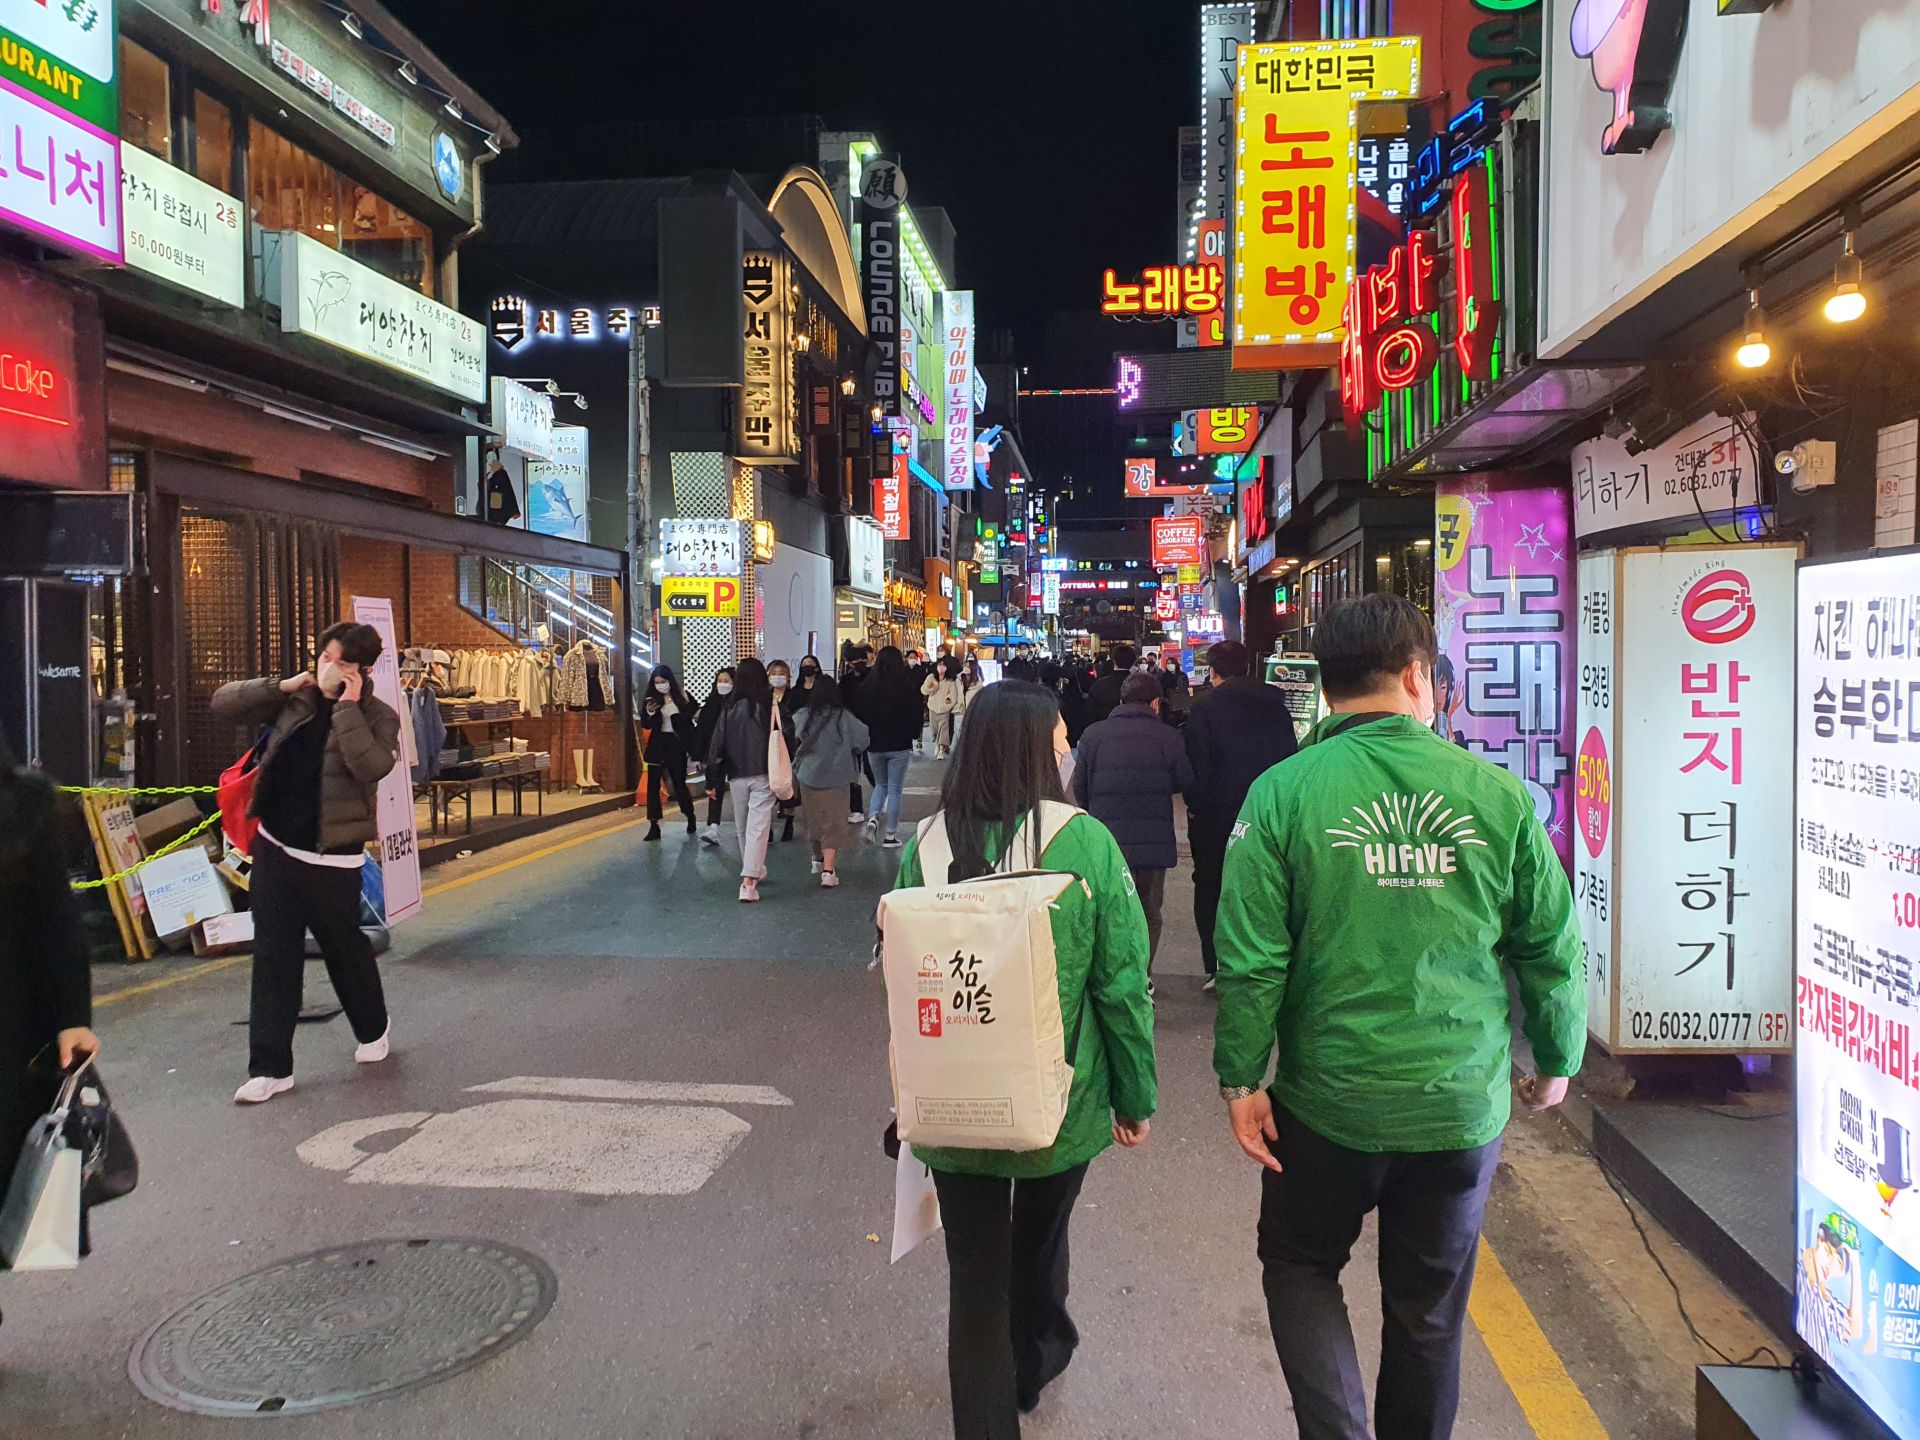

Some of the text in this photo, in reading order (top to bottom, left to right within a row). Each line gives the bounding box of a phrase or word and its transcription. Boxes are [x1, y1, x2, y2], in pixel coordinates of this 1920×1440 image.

[1207, 13, 1250, 26] BEST
[0, 36, 83, 100] URANT
[1255, 54, 1375, 95] 대한민국
[0, 124, 106, 227] 니처
[163, 193, 207, 235] 한접시
[215, 201, 237, 229] 2층
[1261, 112, 1336, 326] 노래방
[130, 230, 205, 276] 50,000원부터
[869, 220, 894, 334] LOUNGE
[1102, 265, 1222, 316] 노래방
[948, 387, 968, 485] 노래연습장
[1209, 407, 1251, 443] 방
[1711, 438, 1740, 466] 3F
[665, 538, 735, 561] 대양참치
[1157, 527, 1197, 538] COFFEE
[713, 581, 736, 612] P
[1582, 590, 1611, 636] 커플링
[1461, 543, 1572, 832] 노래방
[1580, 663, 1611, 710] 우정링
[1578, 755, 1611, 806] 50%
[1588, 805, 1602, 841] 할인
[1674, 660, 1751, 991] 반지 더하기
[148, 870, 210, 900] PRETIGE
[1377, 877, 1446, 888] 하이트진로 서포터즈
[1579, 868, 1608, 924] 가족링
[1631, 1010, 1790, 1042] 02.6032.0777 (3F)
